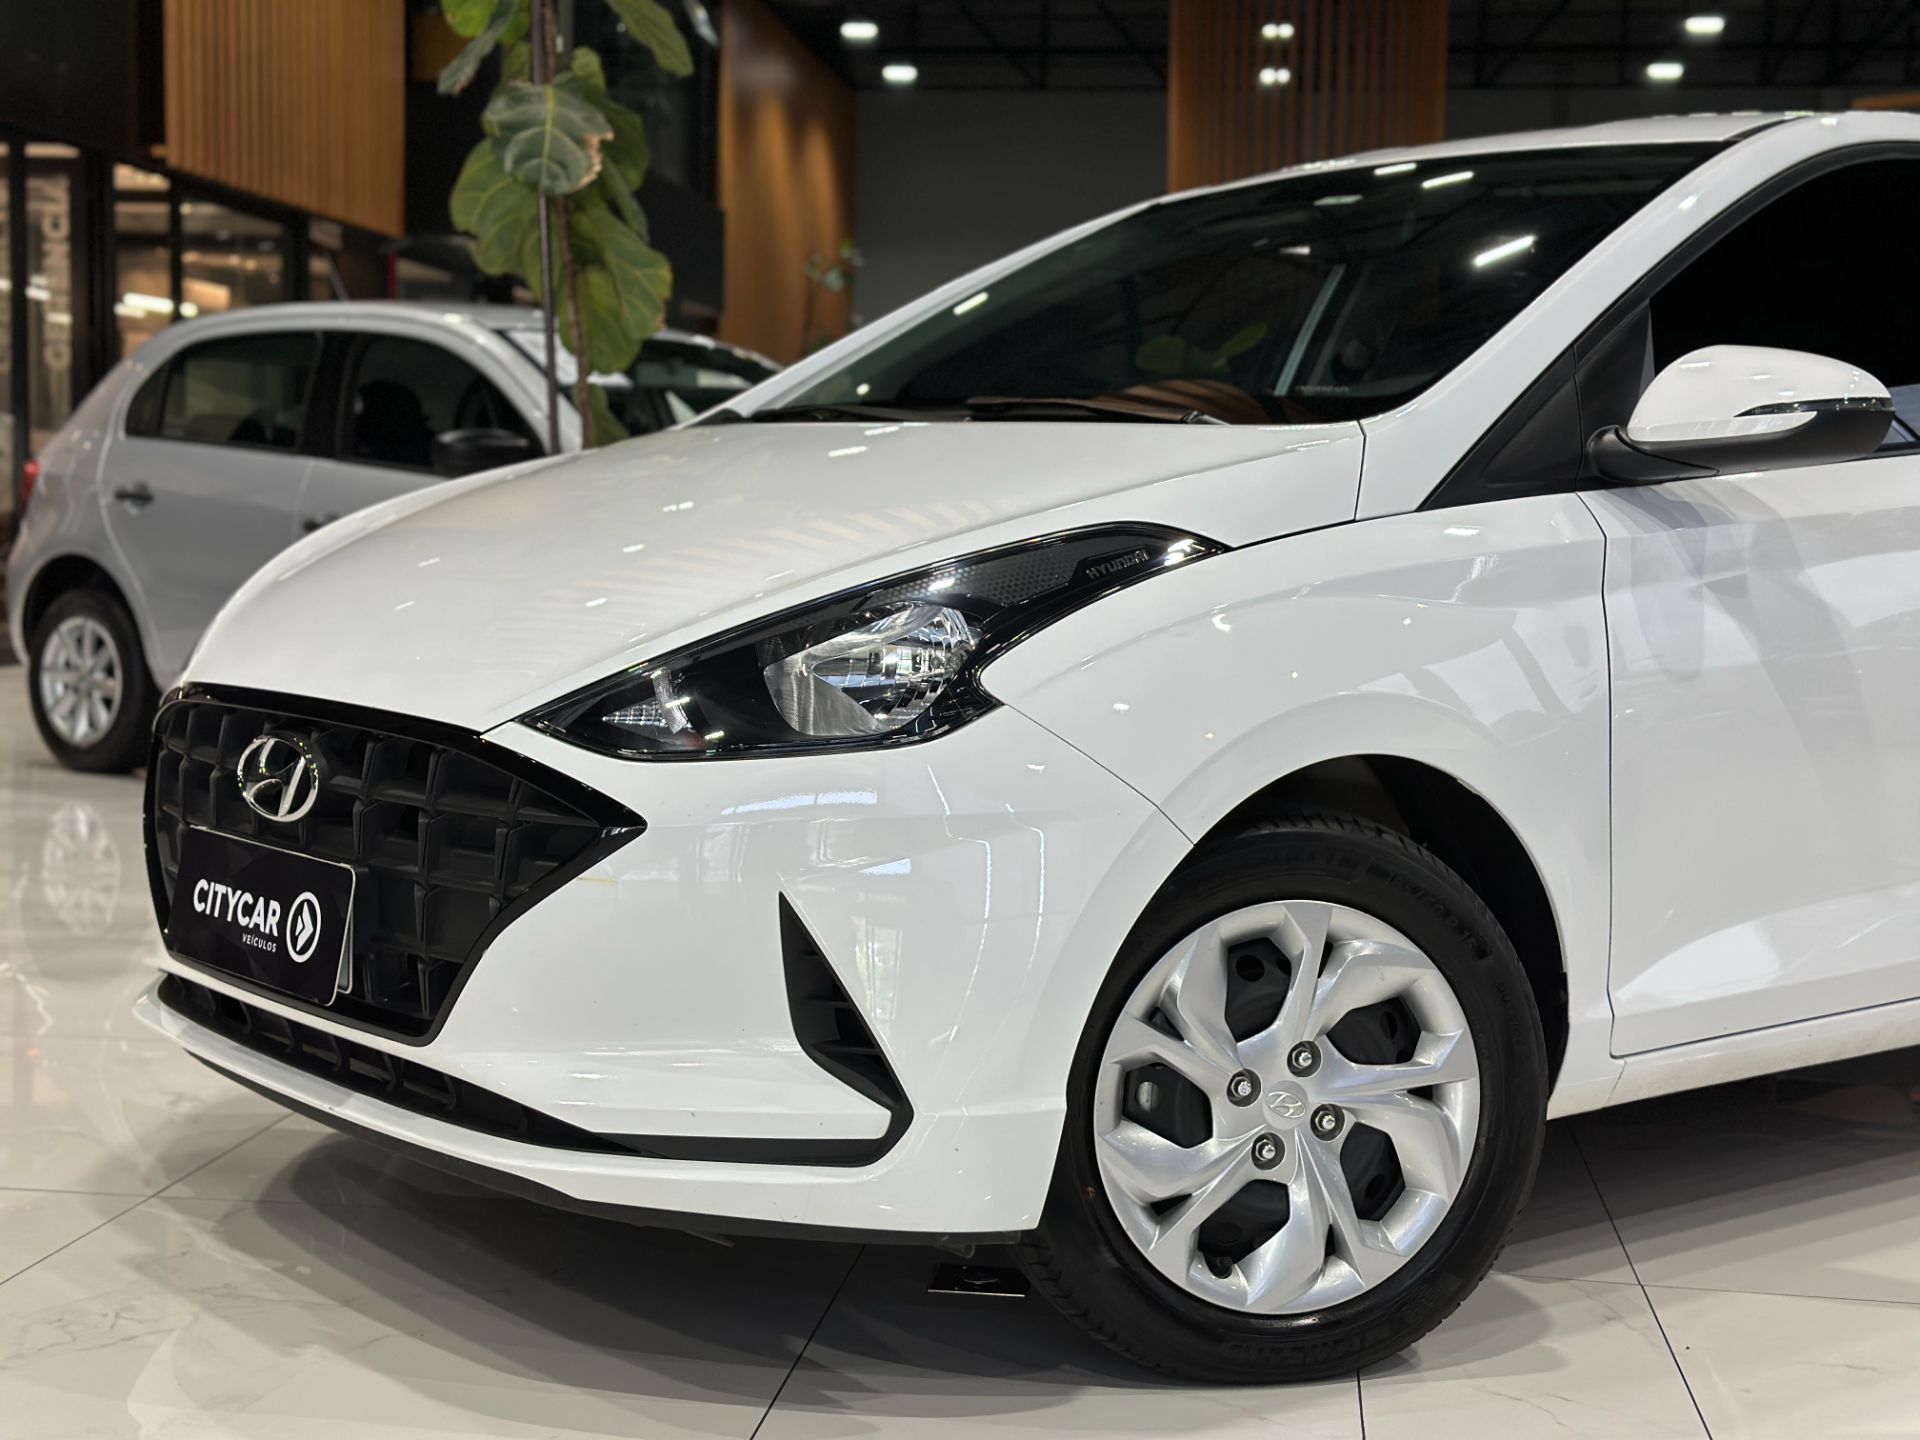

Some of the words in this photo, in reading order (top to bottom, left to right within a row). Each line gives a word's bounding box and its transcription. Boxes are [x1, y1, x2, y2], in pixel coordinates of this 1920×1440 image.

[1086, 550, 1149, 578] HYUNDAI
[193, 879, 281, 937] CITYCAR
[242, 934, 277, 953] VEÍCULOS
